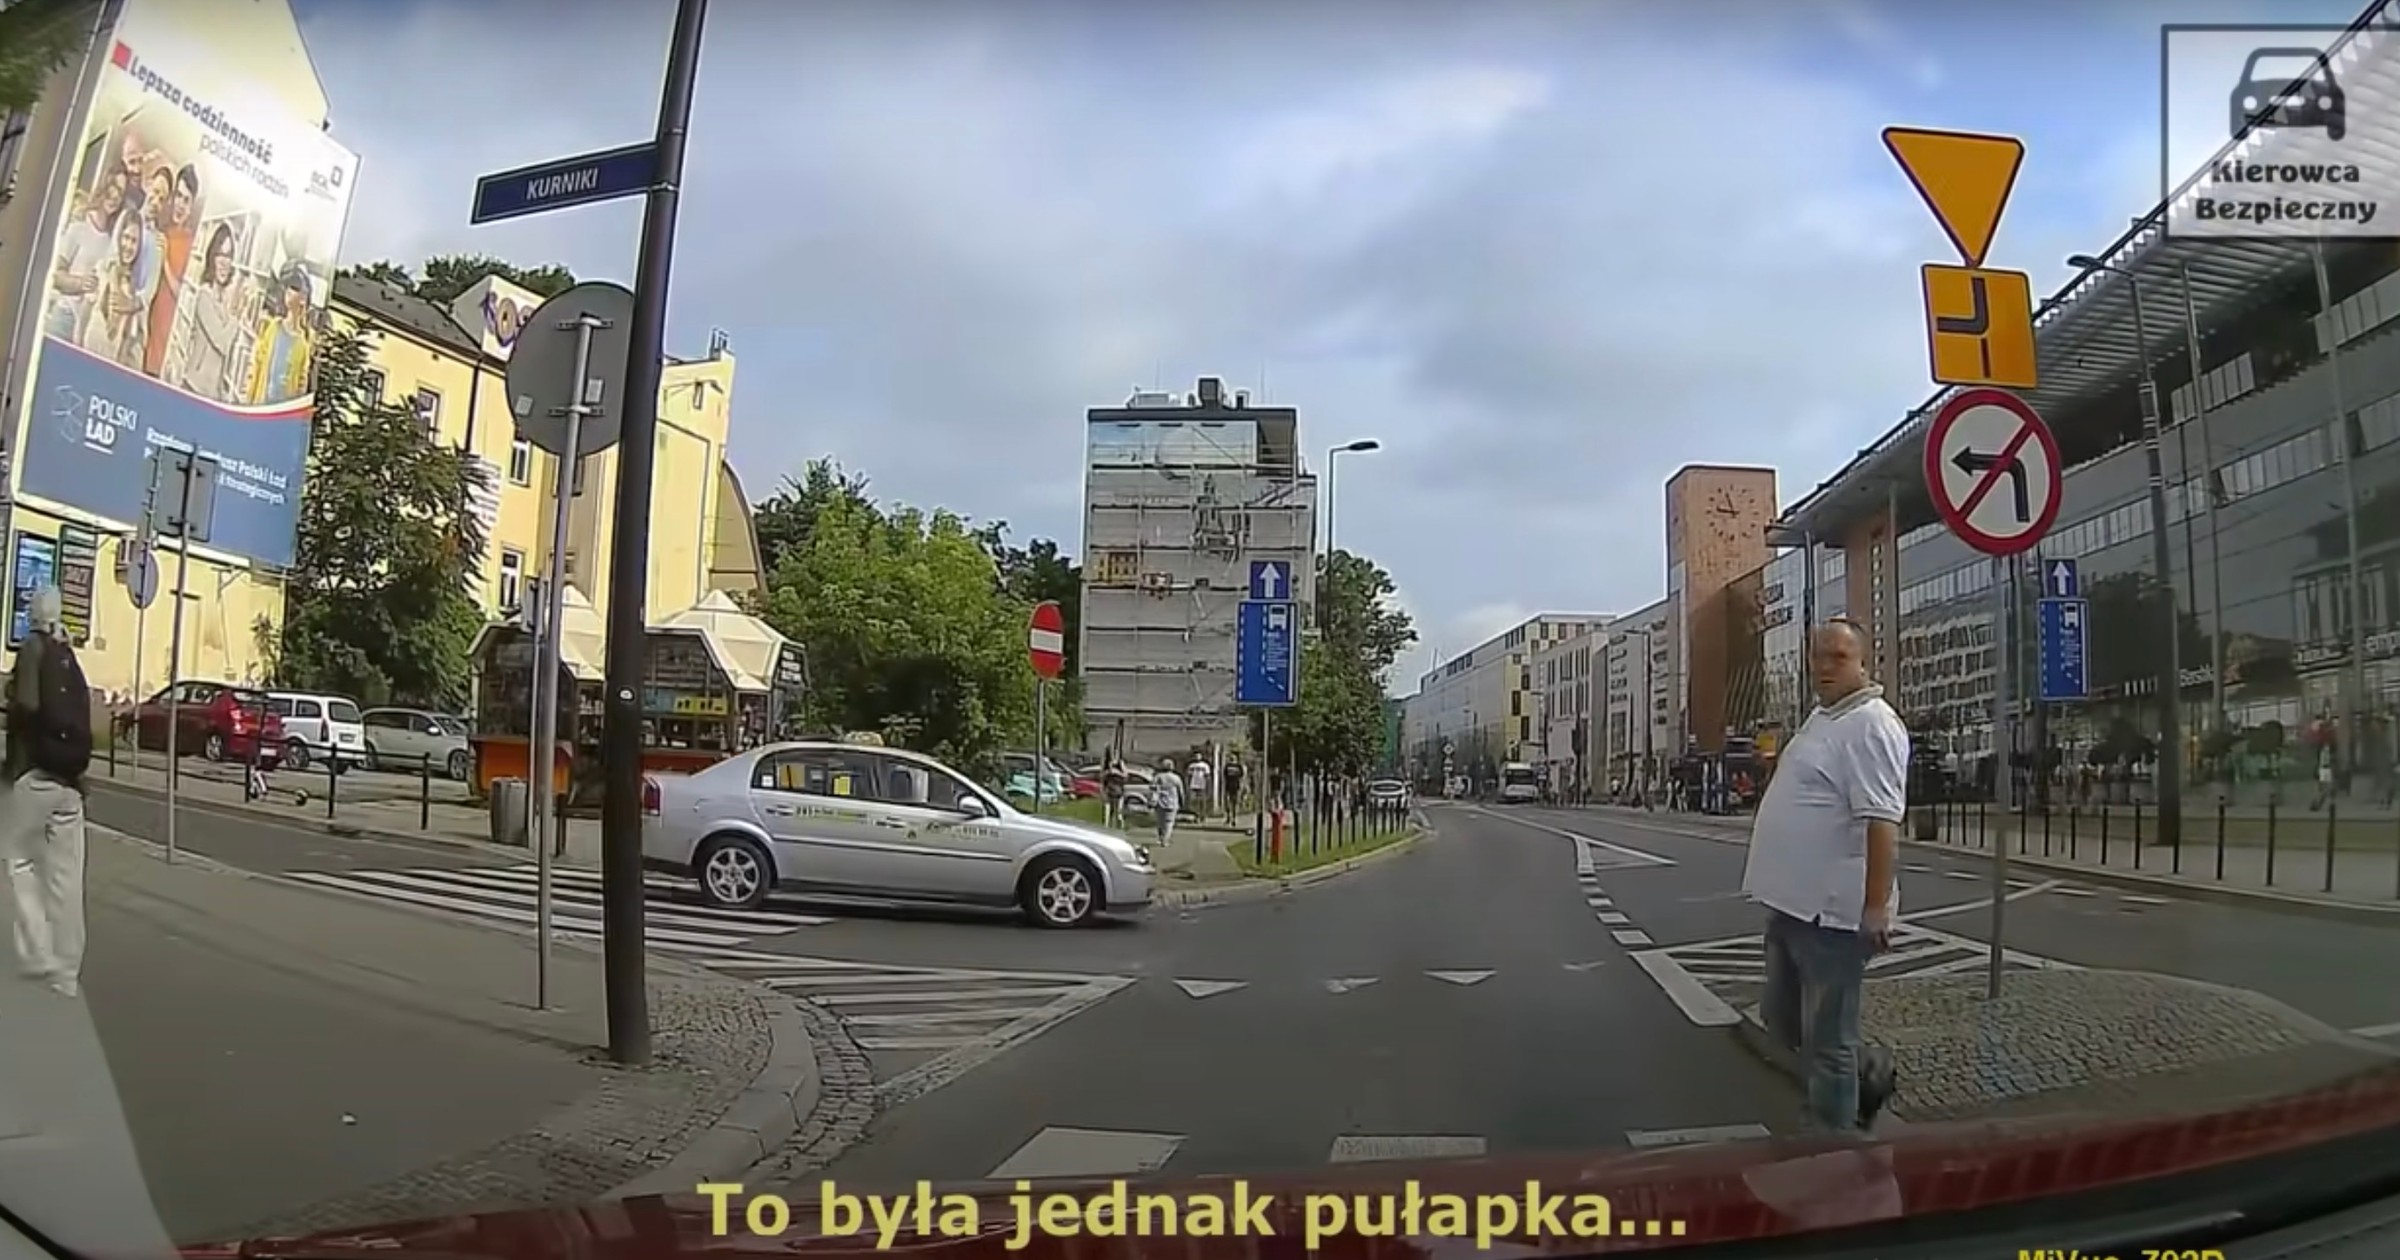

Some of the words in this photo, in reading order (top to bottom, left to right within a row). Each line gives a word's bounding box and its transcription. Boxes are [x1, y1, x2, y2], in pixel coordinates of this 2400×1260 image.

[129, 56, 182, 106] Lepsza
[182, 96, 273, 165] codzienność
[199, 133, 251, 176] polskich
[251, 164, 290, 198] rodzin
[526, 167, 598, 200] KURNIKI
[84, 418, 116, 446] ŁAD
[88, 396, 138, 432] POLSKI
